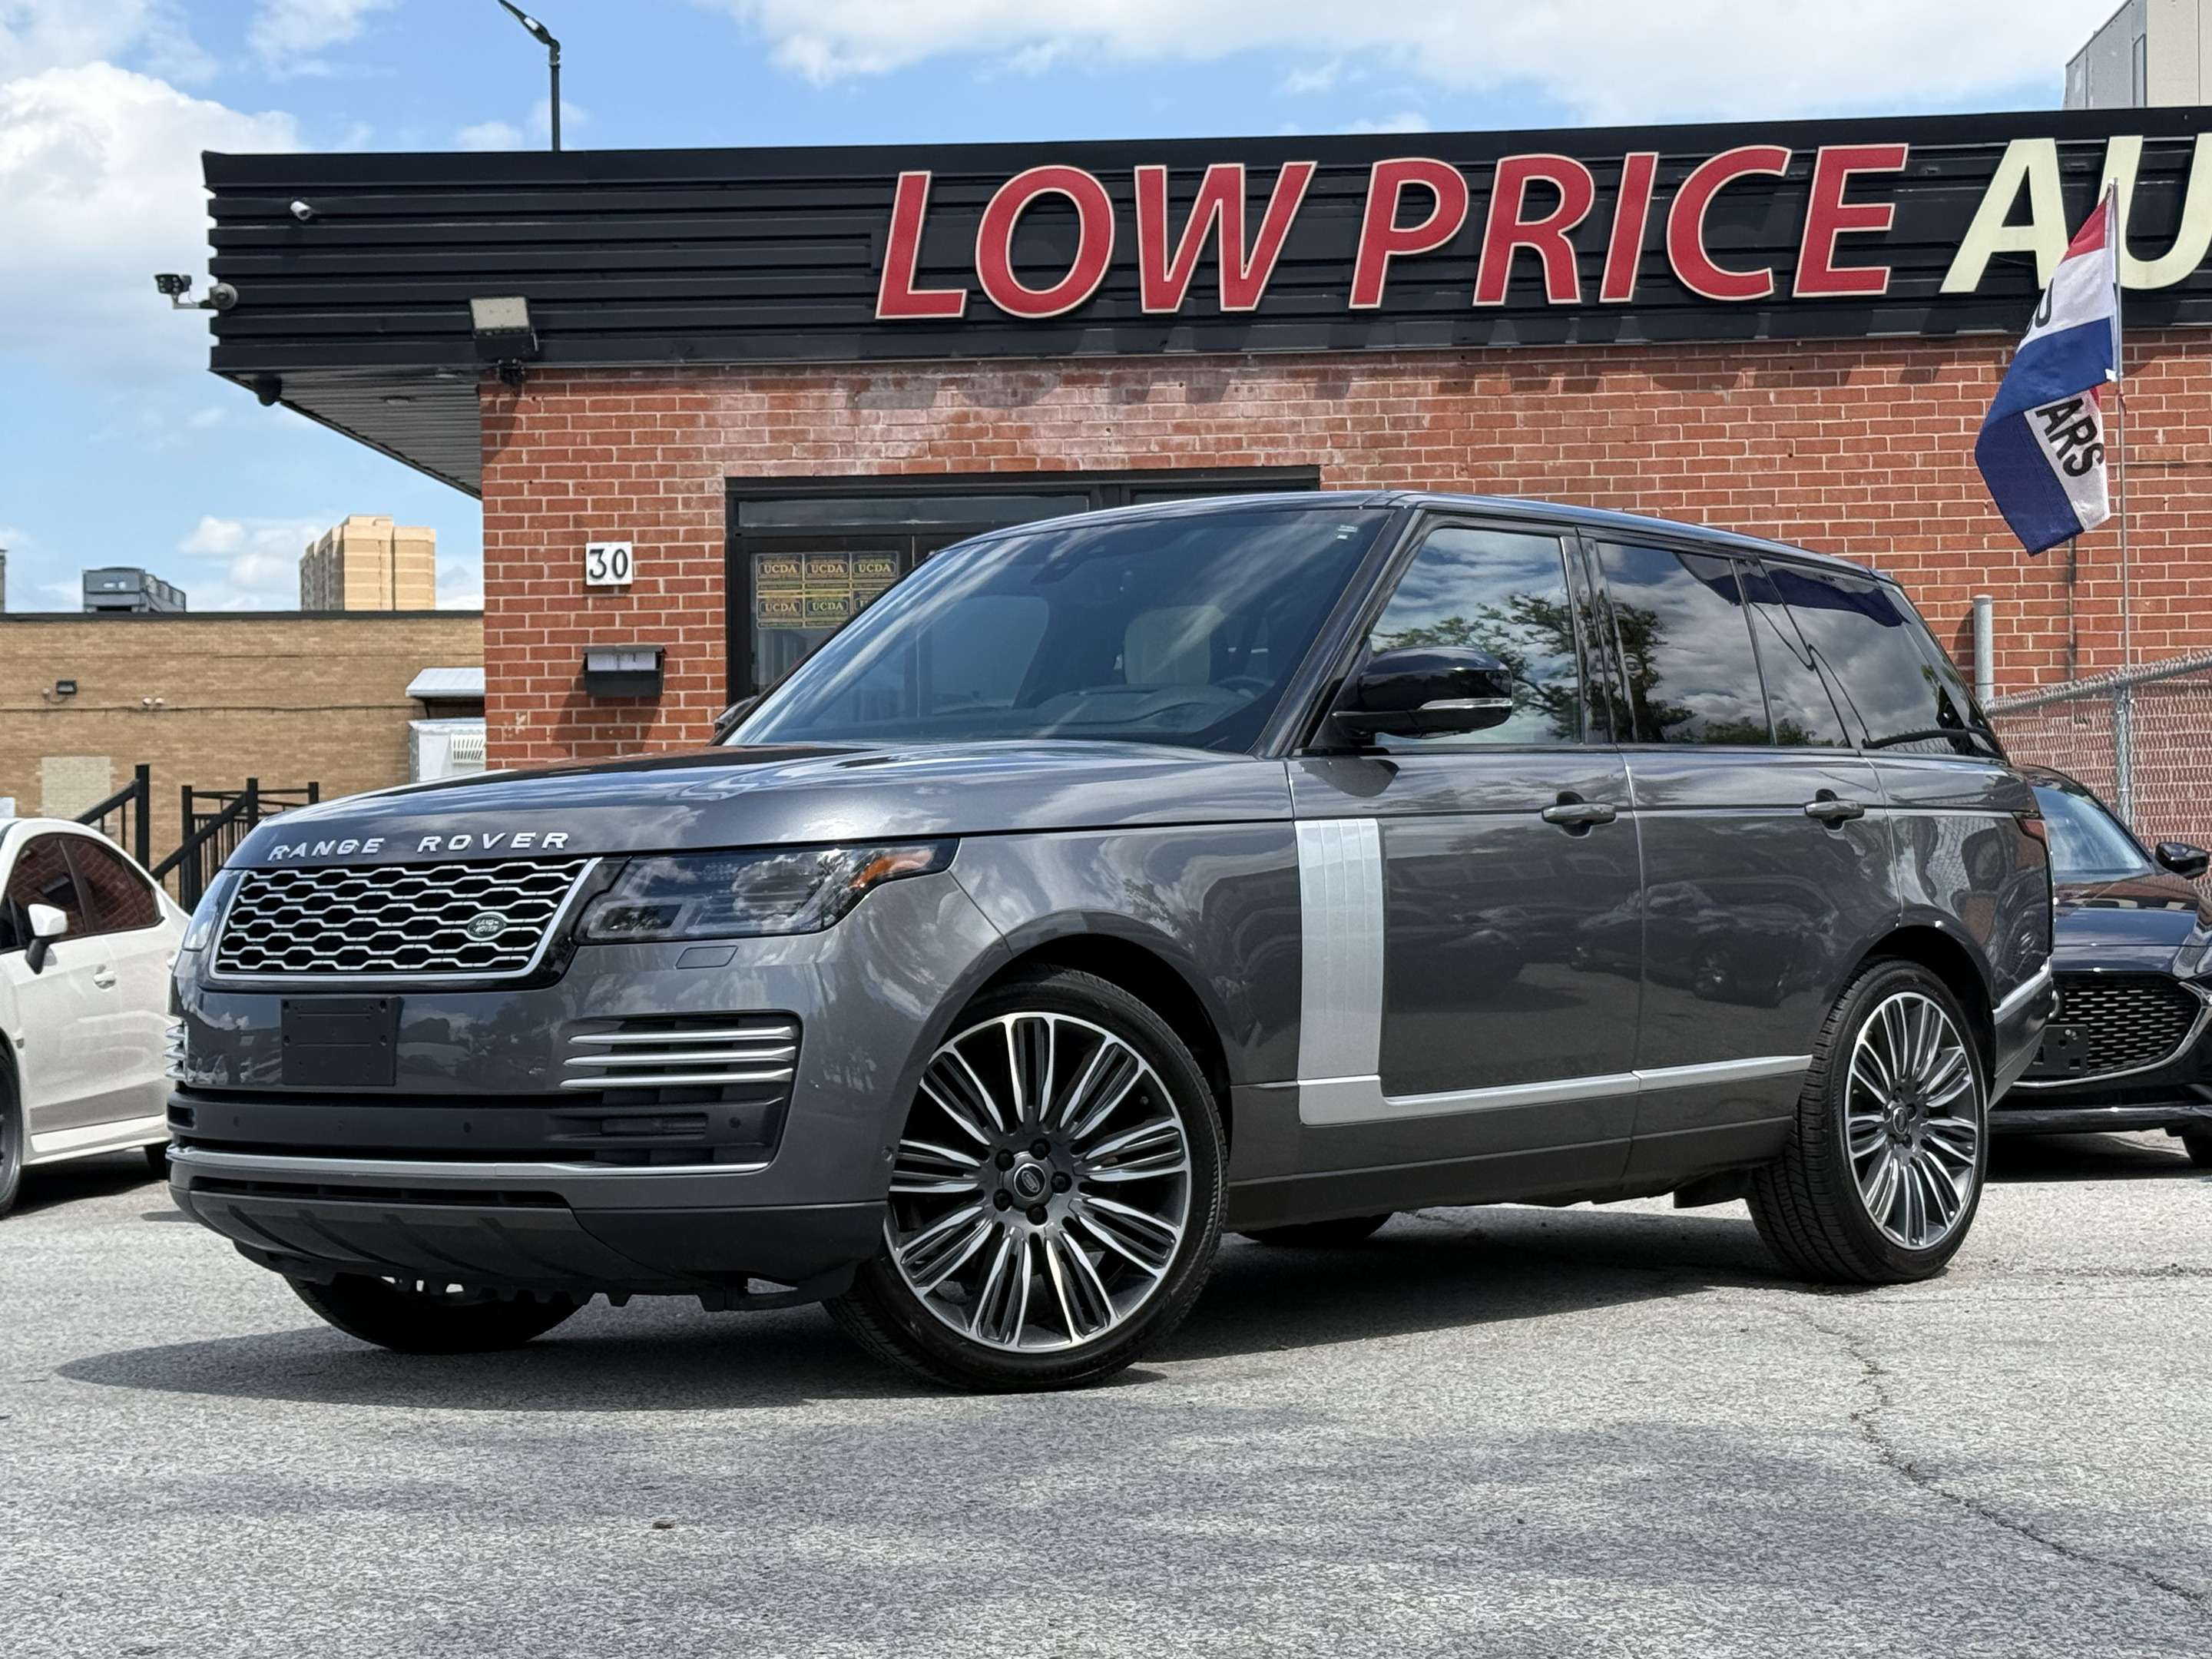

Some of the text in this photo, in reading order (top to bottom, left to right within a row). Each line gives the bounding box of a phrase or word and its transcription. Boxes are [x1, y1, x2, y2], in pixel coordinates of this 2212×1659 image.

[875, 161, 1317, 319] LOW
[1349, 143, 1909, 309] PRICE
[2035, 397, 2105, 477] ARS
[588, 548, 628, 579] 30
[858, 563, 892, 573] UCDA
[763, 565, 798, 574] UCDA
[810, 565, 845, 574] UCDA
[764, 603, 797, 612] UCDA
[812, 601, 843, 611] UCDA
[267, 832, 569, 861] RANGE ROVER
